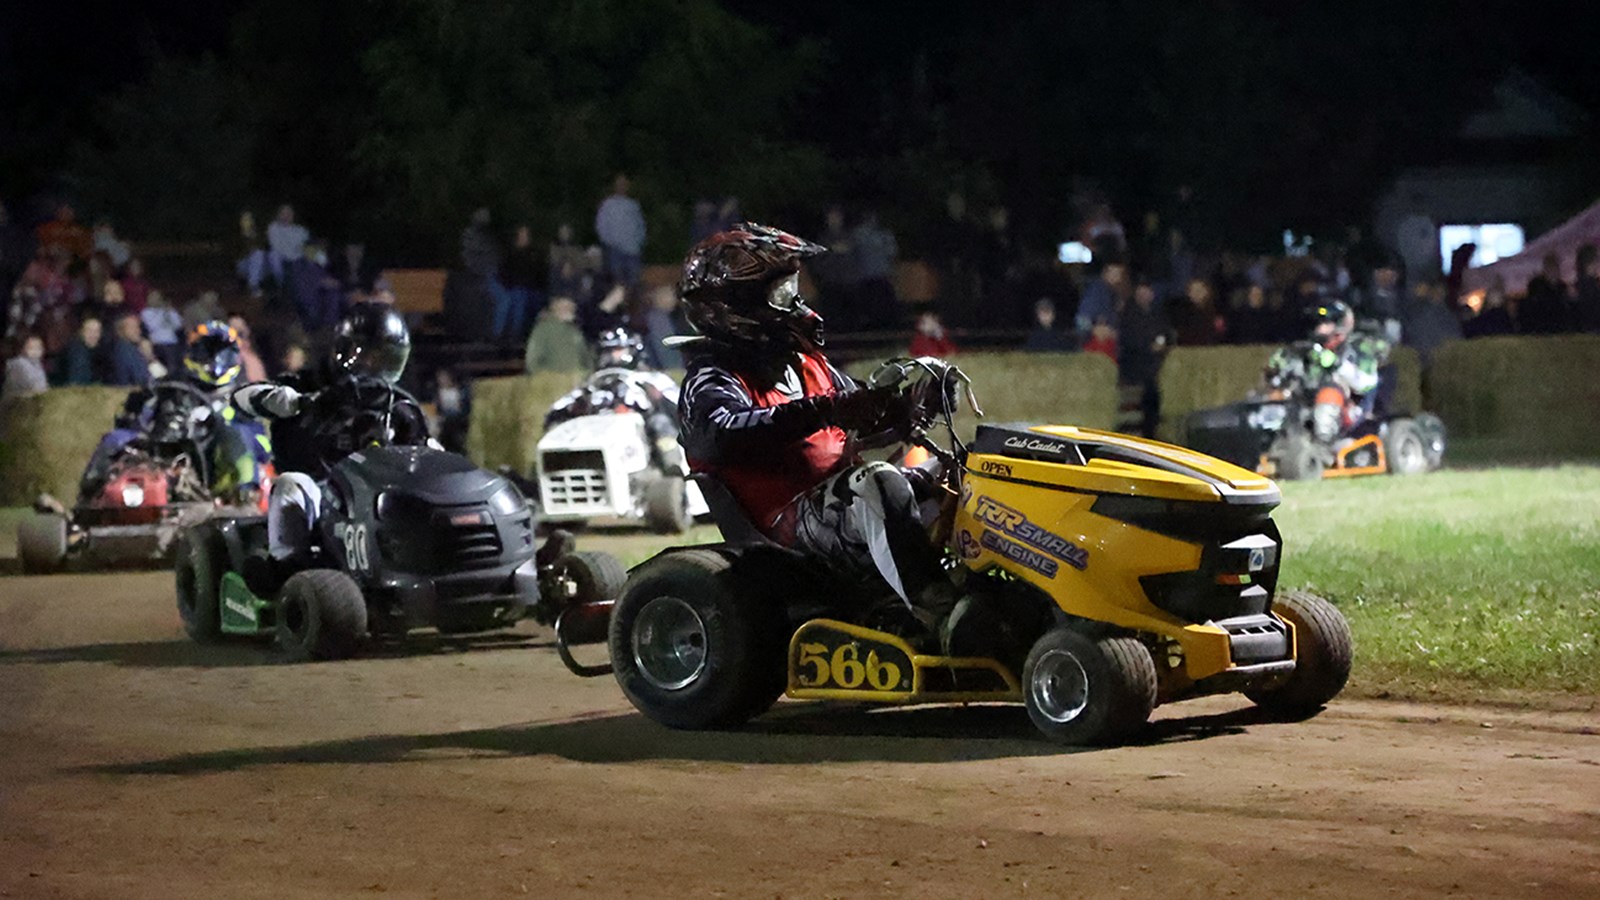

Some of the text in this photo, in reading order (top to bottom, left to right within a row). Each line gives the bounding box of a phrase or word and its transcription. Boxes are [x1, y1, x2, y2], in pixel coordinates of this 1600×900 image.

[1005, 437, 1065, 453] Cub Cadet
[981, 461, 1013, 477] OPEN
[975, 497, 1087, 568] RR SMALL
[983, 531, 1058, 576] ENGINE
[799, 642, 900, 690] 566
